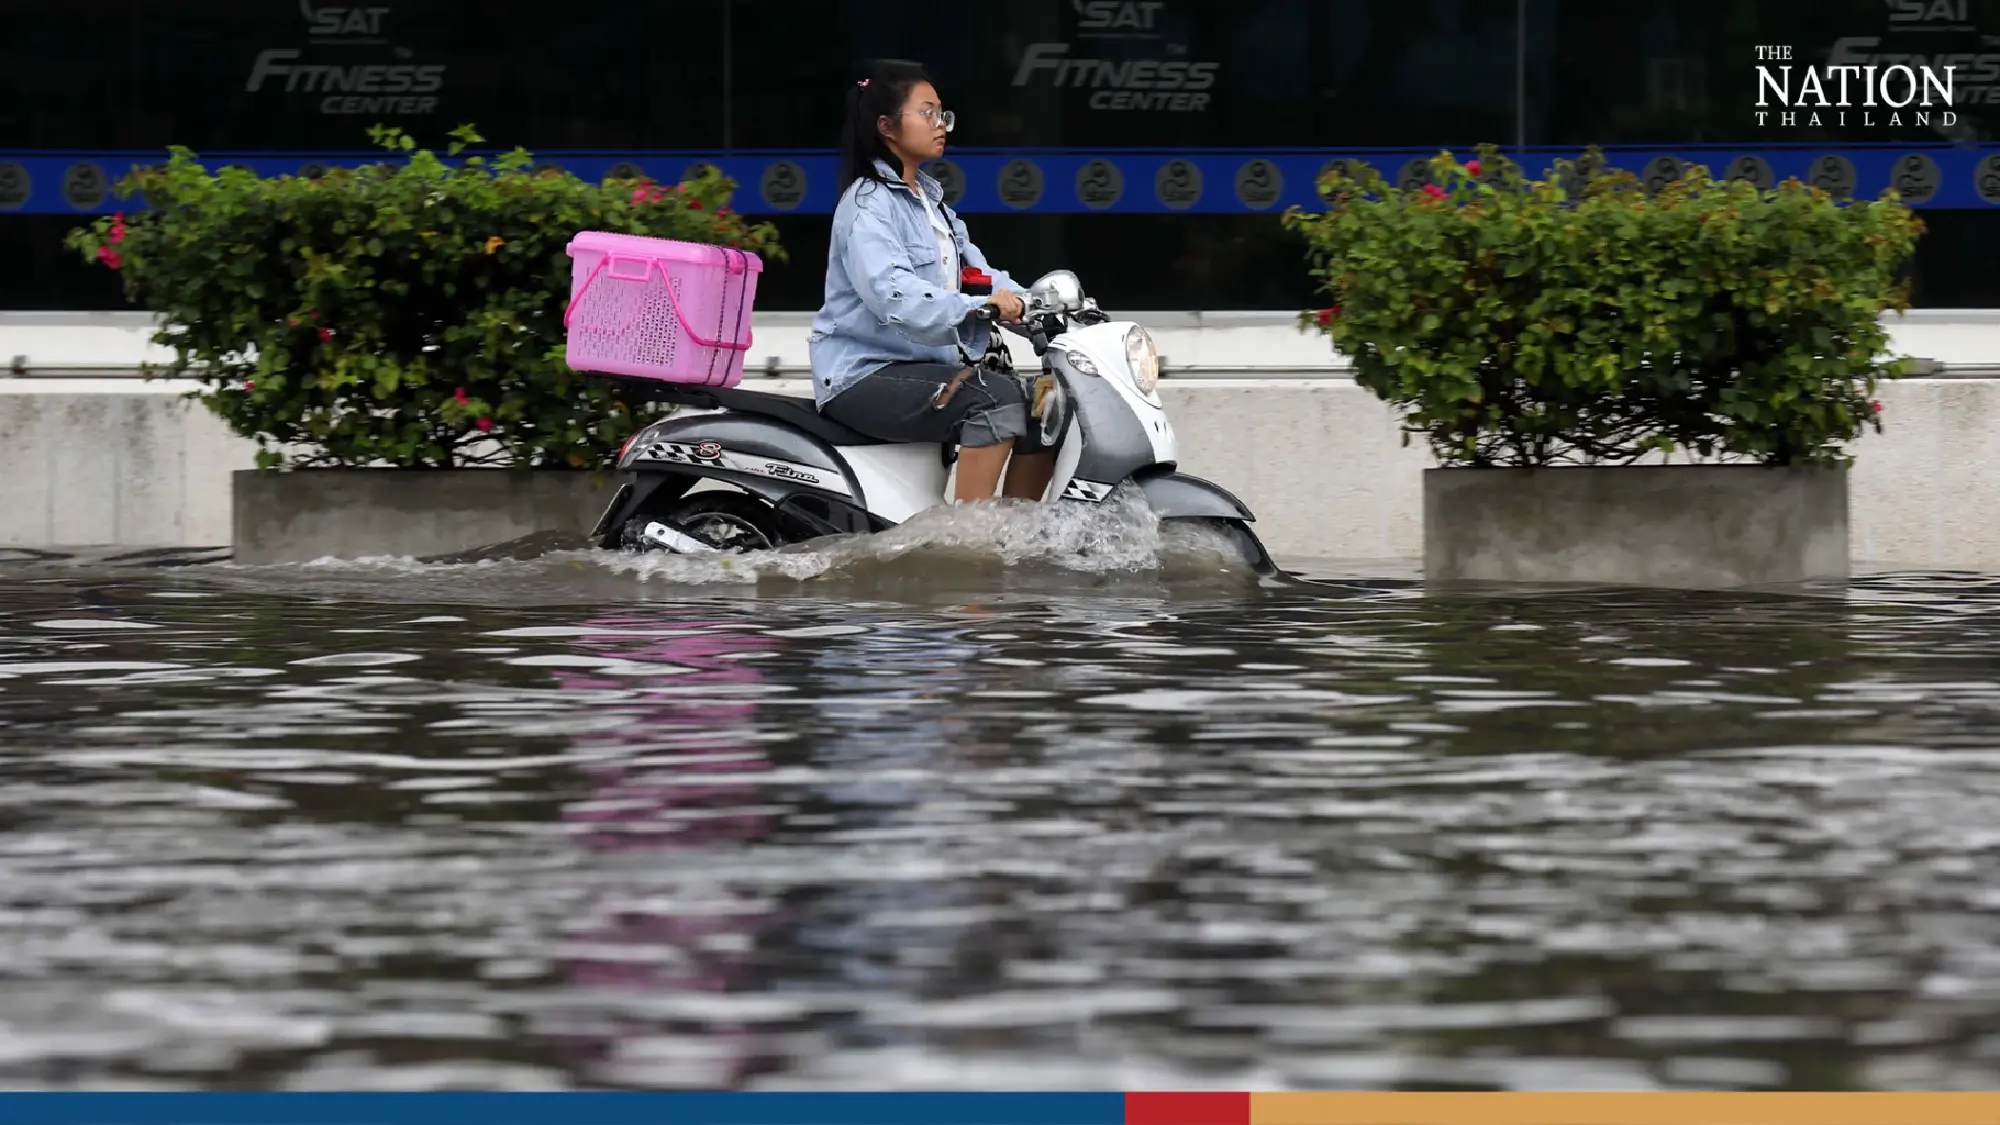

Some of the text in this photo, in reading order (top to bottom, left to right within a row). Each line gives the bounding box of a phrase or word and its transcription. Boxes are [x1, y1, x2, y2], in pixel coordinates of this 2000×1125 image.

[308, 7, 390, 34] SAT
[1078, 1, 1164, 28] SAT
[245, 48, 447, 92] FITNESS
[1010, 42, 1220, 89] FITNESS
[320, 96, 439, 114] CENTER
[1088, 90, 1211, 111] CENTER
